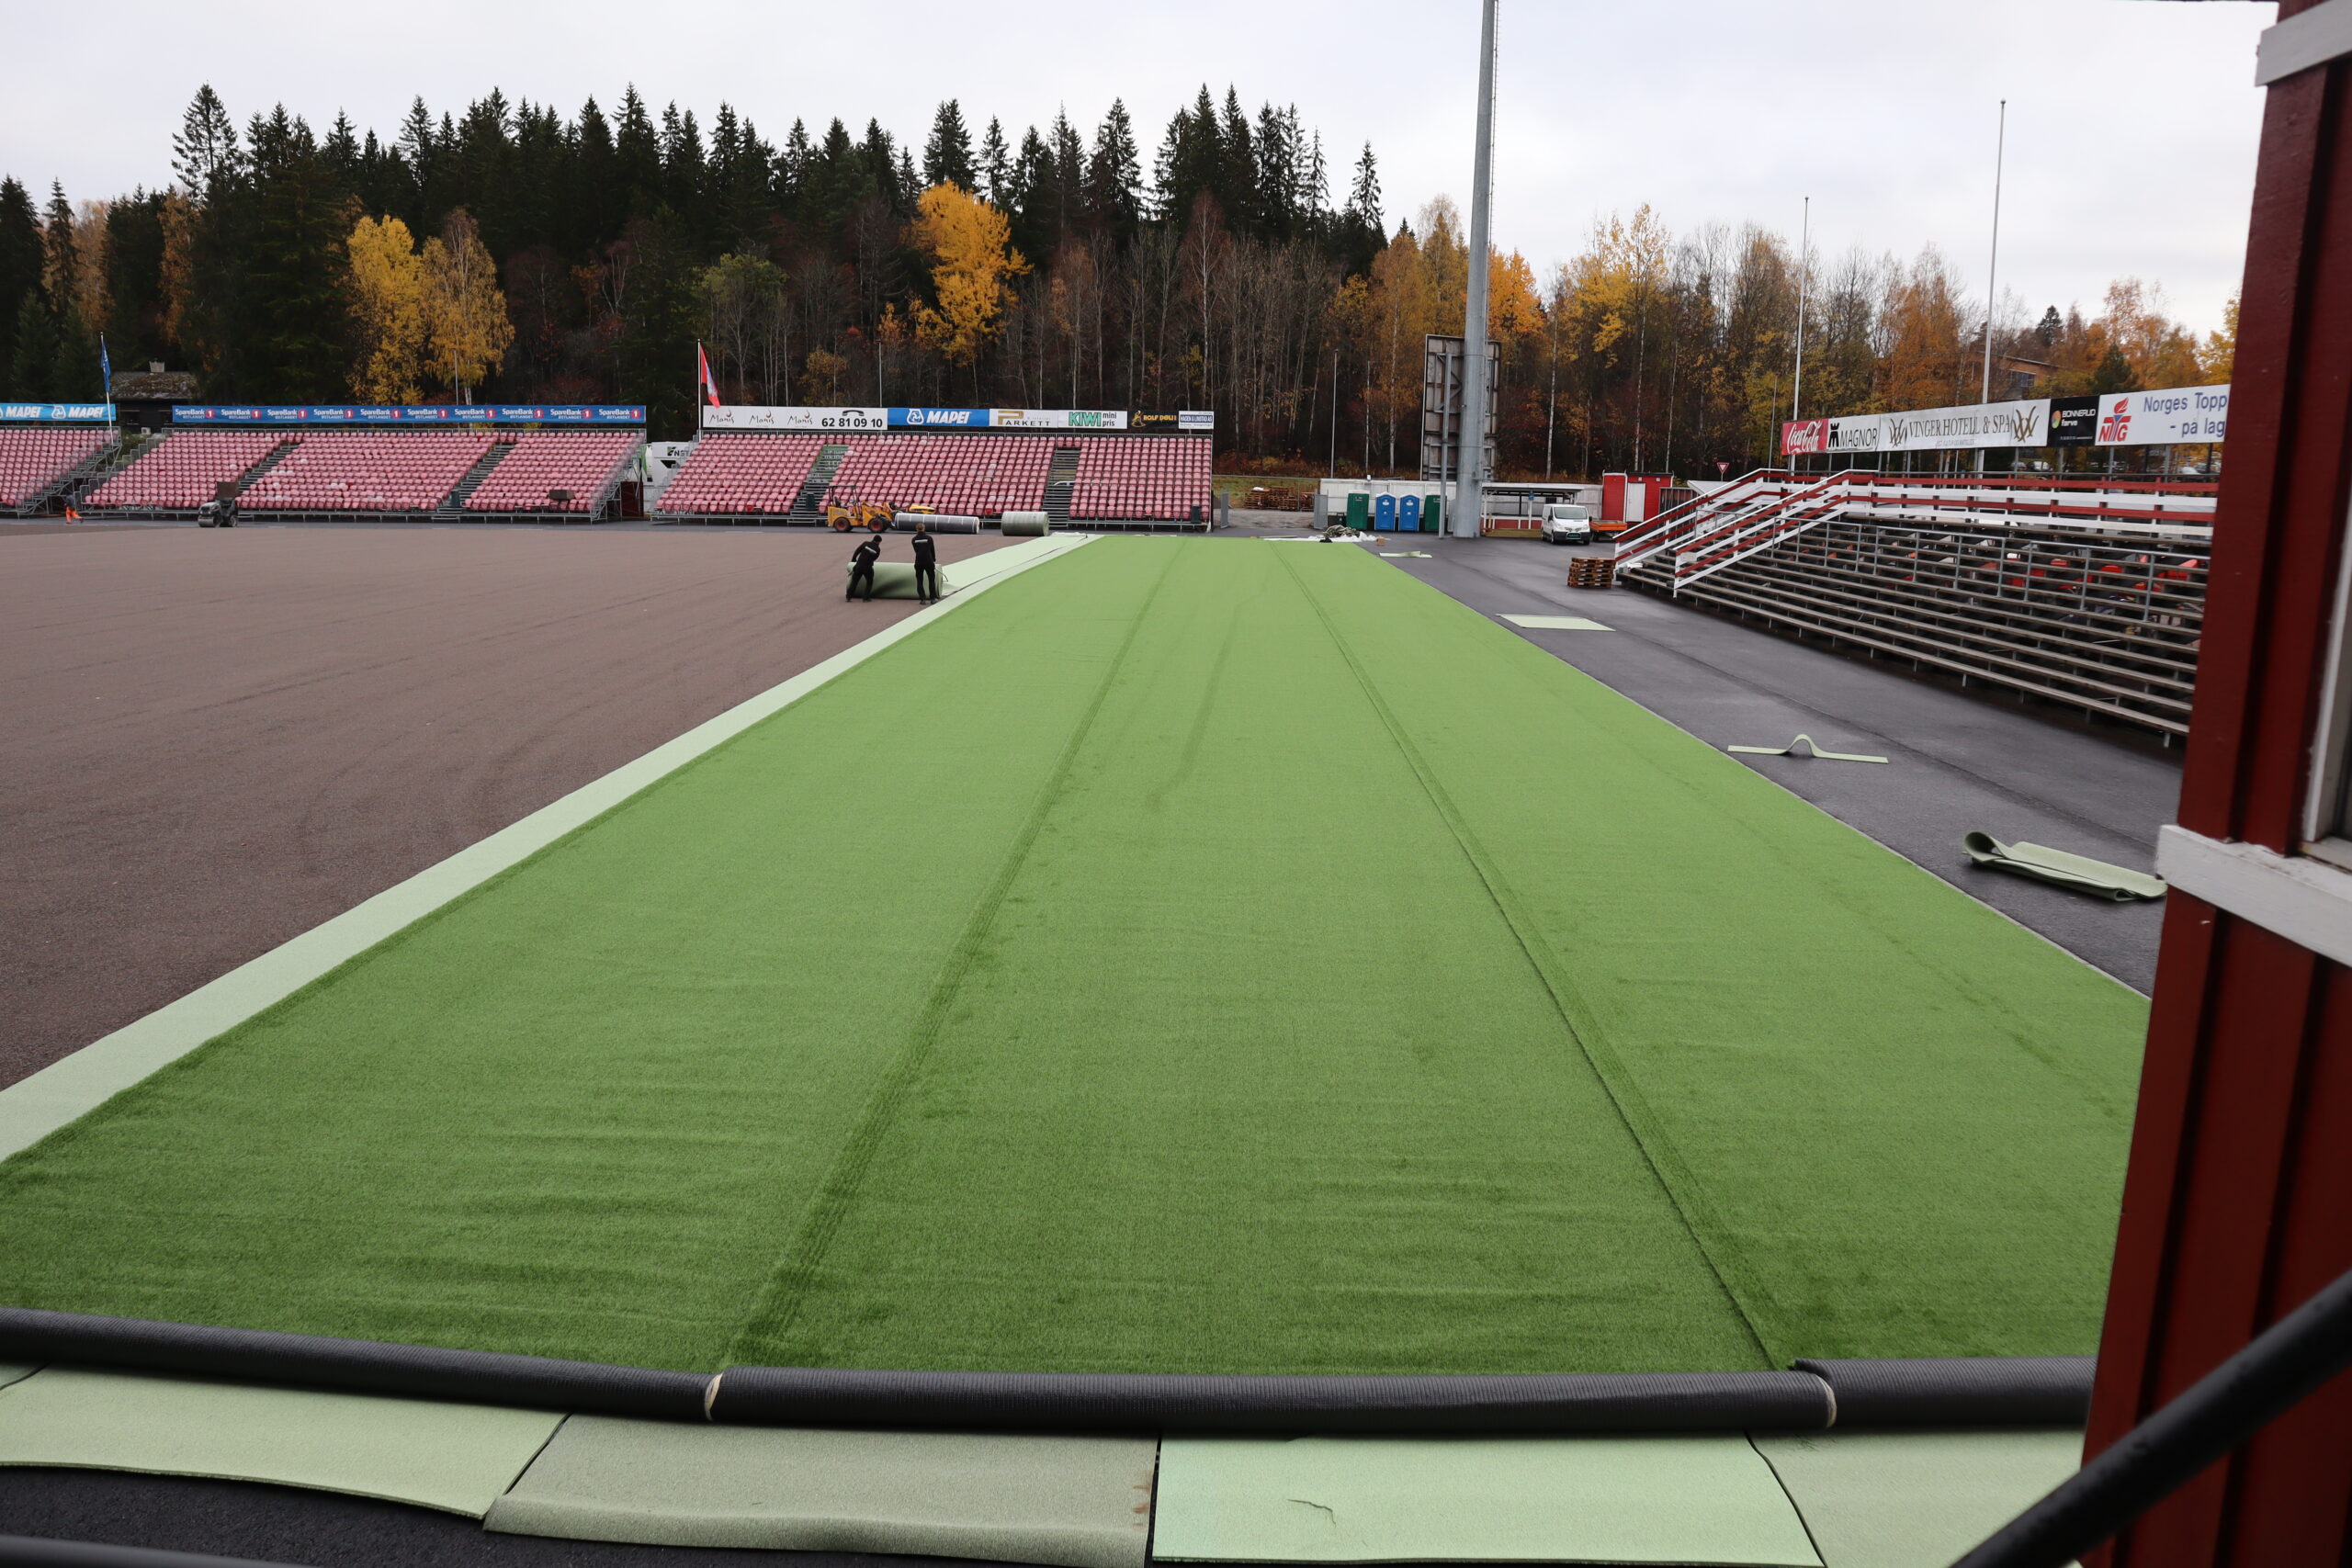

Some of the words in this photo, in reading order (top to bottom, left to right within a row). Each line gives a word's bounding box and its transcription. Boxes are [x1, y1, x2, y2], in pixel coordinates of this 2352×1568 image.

[6, 406, 43, 418] MAPEI
[68, 406, 106, 418] MAPEI
[2143, 396, 2188, 414] Norges
[821, 417, 835, 427] 62
[838, 418, 851, 427] 81
[854, 418, 867, 428] 09
[870, 418, 883, 428] 10
[926, 411, 970, 424] MAPEI
[1069, 412, 1102, 427] KIWI
[1908, 418, 1941, 438] VINGER
[1942, 415, 1980, 436] HOTELL
[1984, 415, 1991, 434] &
[1992, 413, 2011, 434] SPA
[1840, 428, 1878, 448] MAGNOR
